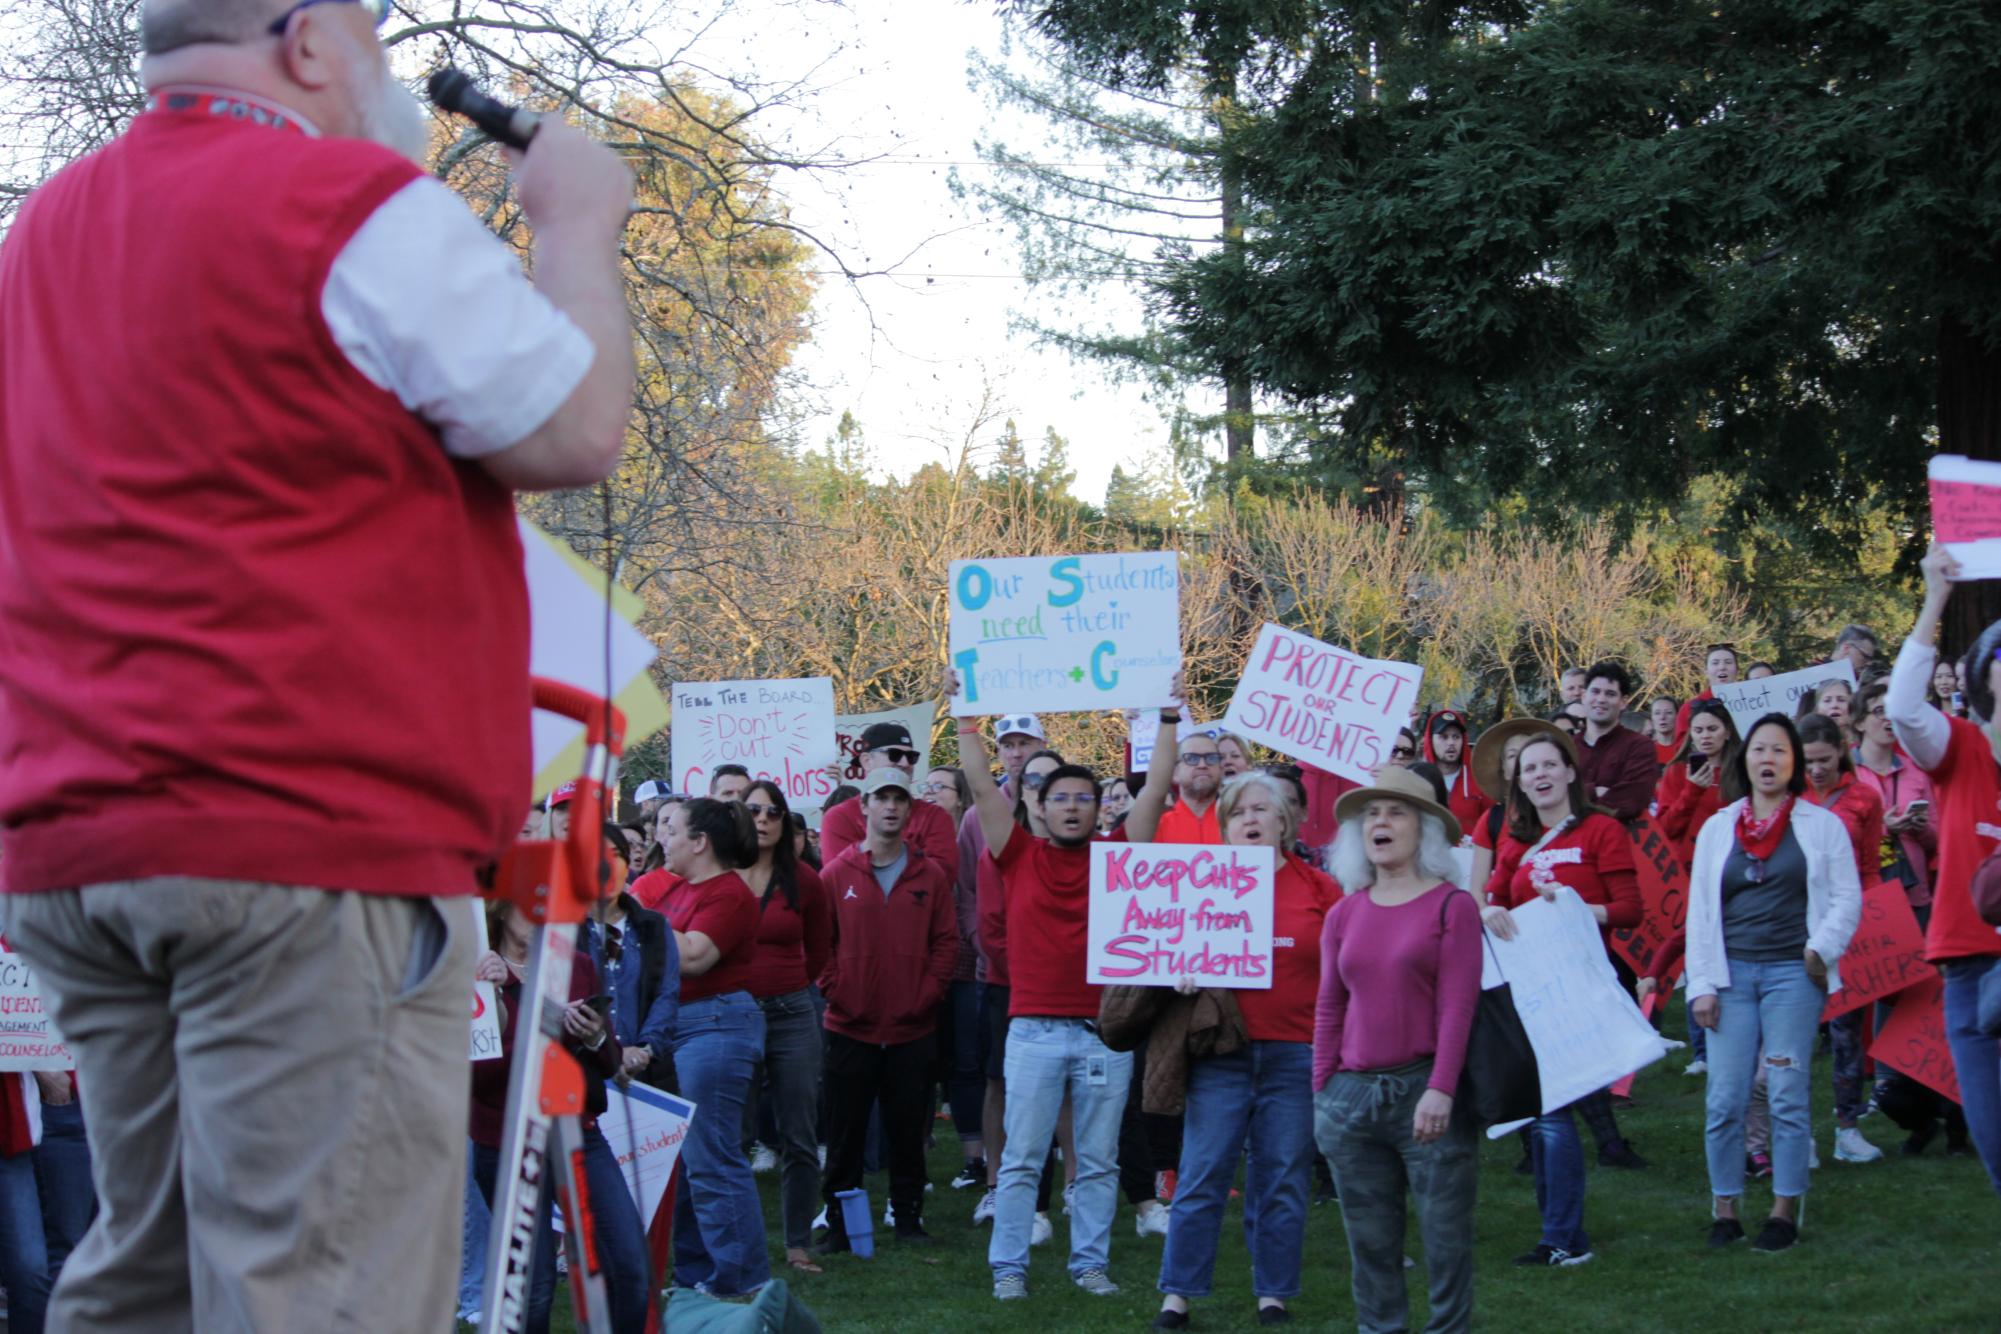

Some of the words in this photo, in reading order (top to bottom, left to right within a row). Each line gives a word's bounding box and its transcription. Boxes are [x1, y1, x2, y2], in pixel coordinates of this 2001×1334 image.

[956, 564, 1023, 611] Our
[1047, 556, 1176, 607] Students
[981, 604, 1045, 638] need
[1060, 601, 1132, 632] their
[717, 688, 749, 706] THE
[954, 647, 1068, 703] Teachers
[1261, 635, 1411, 715] PROTECT
[1717, 684, 1771, 712] Protect
[717, 707, 787, 739] Don't
[1303, 693, 1337, 715] OUR
[1239, 690, 1381, 771] STUDENTS
[1105, 847, 1189, 902] Keep
[1189, 851, 1260, 900] Cuts
[1625, 818, 1679, 884] KEEP
[1121, 894, 1185, 945] Away
[1189, 898, 1253, 932] from
[1099, 935, 1267, 977] Students
